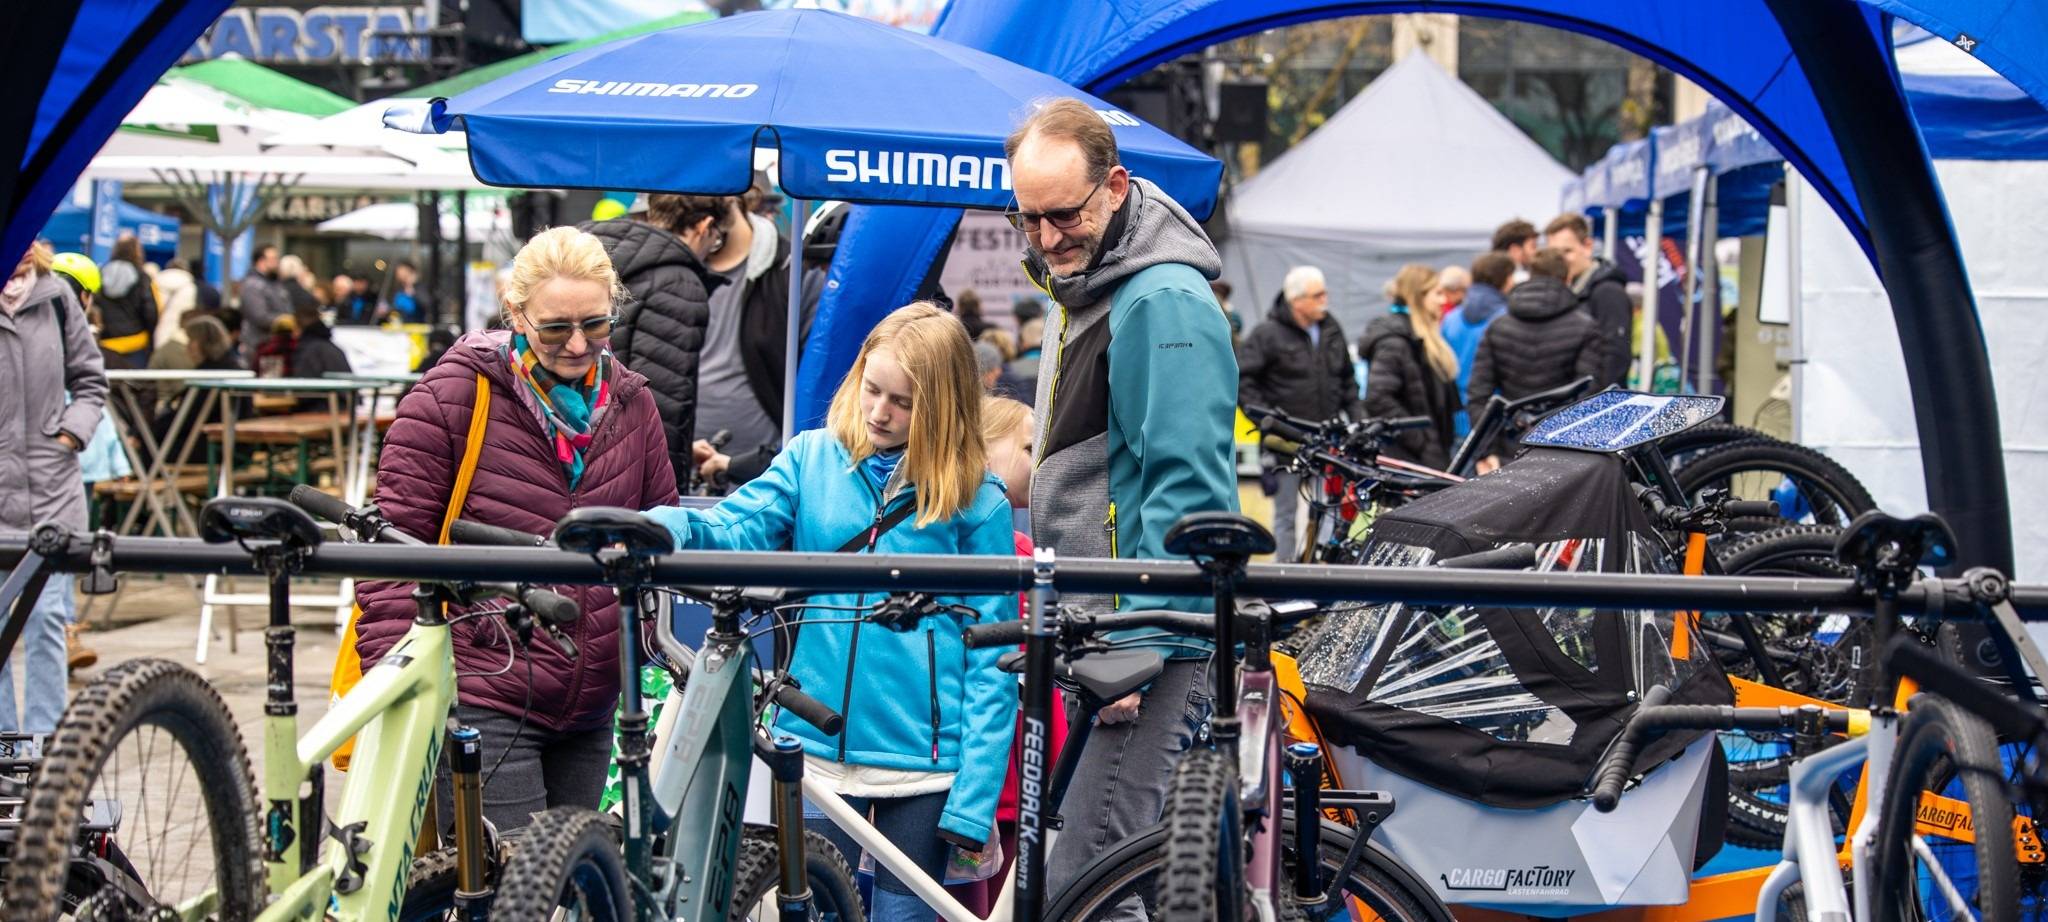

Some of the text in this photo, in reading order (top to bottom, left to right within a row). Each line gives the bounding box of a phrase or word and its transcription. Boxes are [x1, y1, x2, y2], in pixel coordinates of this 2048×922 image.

[182, 7, 428, 62] ARSTA
[548, 79, 759, 97] SHIMANO
[825, 149, 1012, 190] SHIMAN
[956, 227, 1025, 250] FESTI
[1017, 716, 1045, 890] FEEDBACK SPORTS
[1727, 791, 1788, 824] MAXXI
[388, 726, 440, 922] NTA CRUZ
